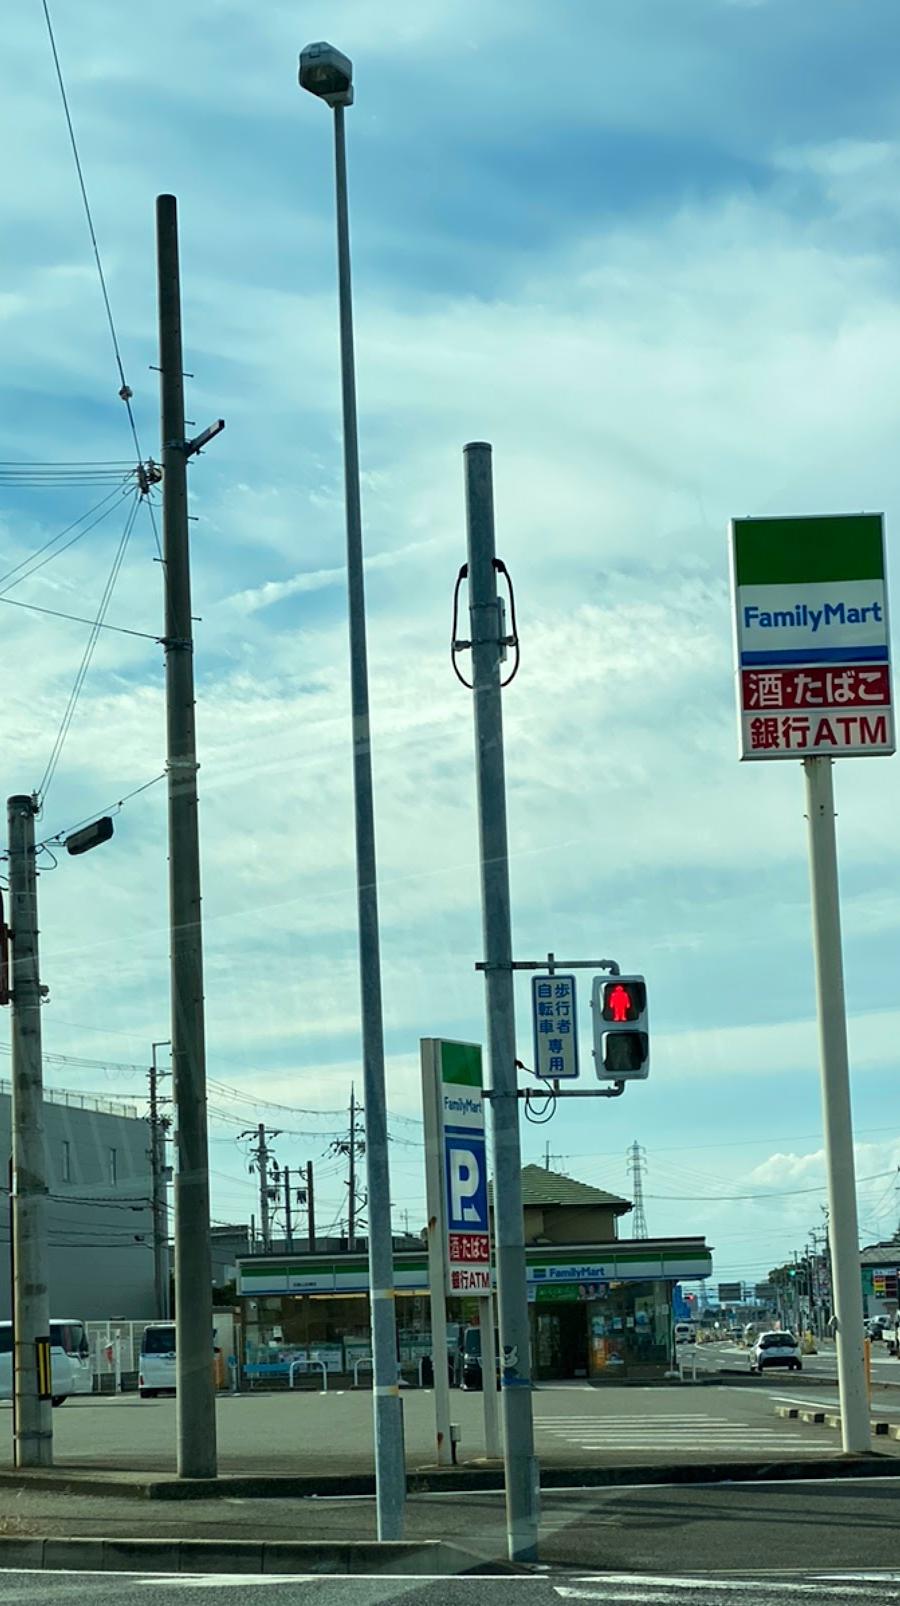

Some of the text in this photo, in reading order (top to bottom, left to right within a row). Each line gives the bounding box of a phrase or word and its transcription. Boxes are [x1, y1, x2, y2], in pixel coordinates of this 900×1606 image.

[744, 602, 883, 632] FamilyMart
[750, 715, 888, 750] 銀行ATM
[538, 983, 553, 1033] 自転車
[555, 983, 571, 1033] 歩行者
[549, 1038, 564, 1071] 専用
[444, 1096, 482, 1115] FamilyMart
[449, 1148, 481, 1222] P
[549, 1266, 605, 1278] FamilyMart
